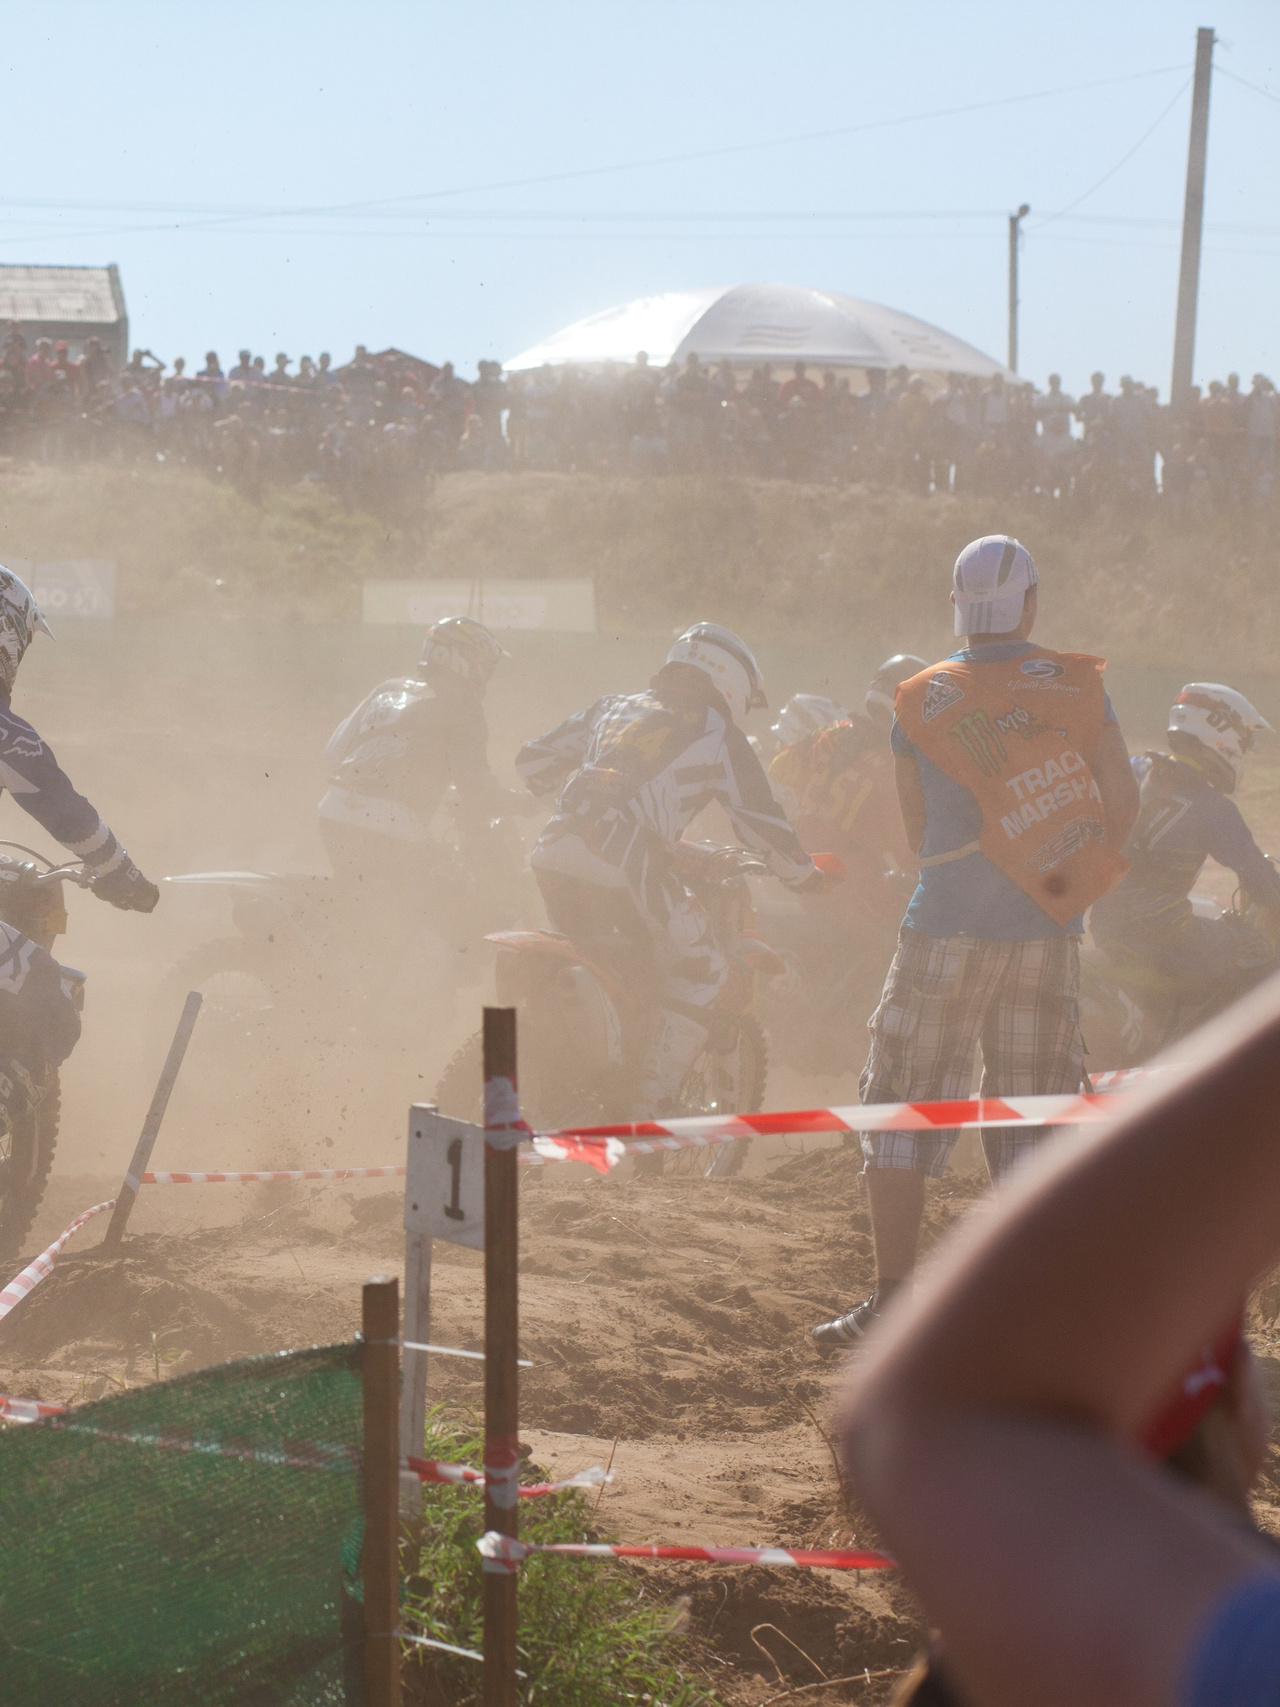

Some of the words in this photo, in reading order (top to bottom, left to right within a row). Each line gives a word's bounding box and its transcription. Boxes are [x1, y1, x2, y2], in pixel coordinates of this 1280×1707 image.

[1005, 750, 1086, 800] TRAC
[1000, 776, 1102, 840] MARSHA
[443, 1134, 467, 1222] 1
